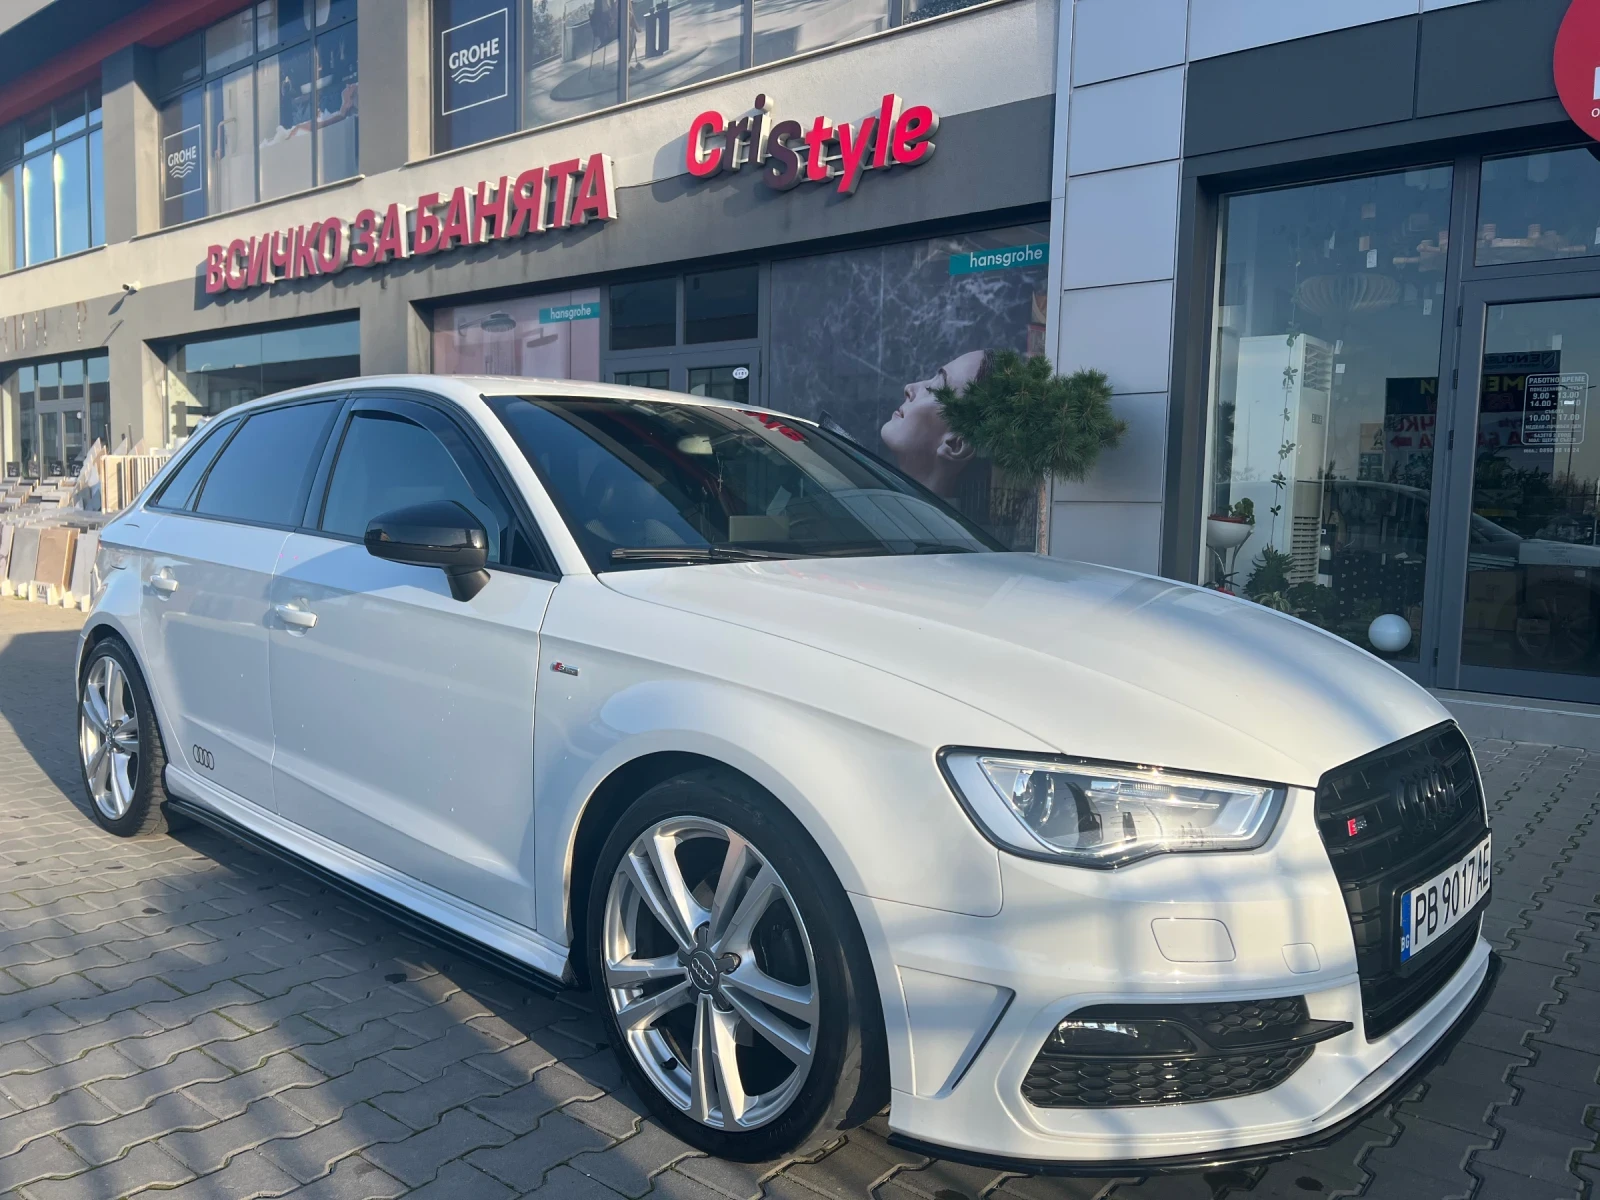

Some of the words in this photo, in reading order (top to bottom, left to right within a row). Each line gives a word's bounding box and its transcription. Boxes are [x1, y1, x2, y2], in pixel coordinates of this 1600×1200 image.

[448, 37, 500, 69] GROHE
[167, 145, 197, 167] GROHE
[206, 216, 350, 294] ВСИЧКО
[351, 202, 407, 267] ЗА
[413, 153, 616, 256] БАНЯТА
[969, 244, 1043, 268] hansgrohe
[550, 303, 592, 320] hansgrohe
[1528, 376, 1560, 384] РАБОТНО
[1561, 375, 1586, 383] ВРЕМЕ
[1558, 391, 1580, 399] 13.00
[1442, 856, 1476, 925] 9017
[1400, 934, 1410, 953] BG
